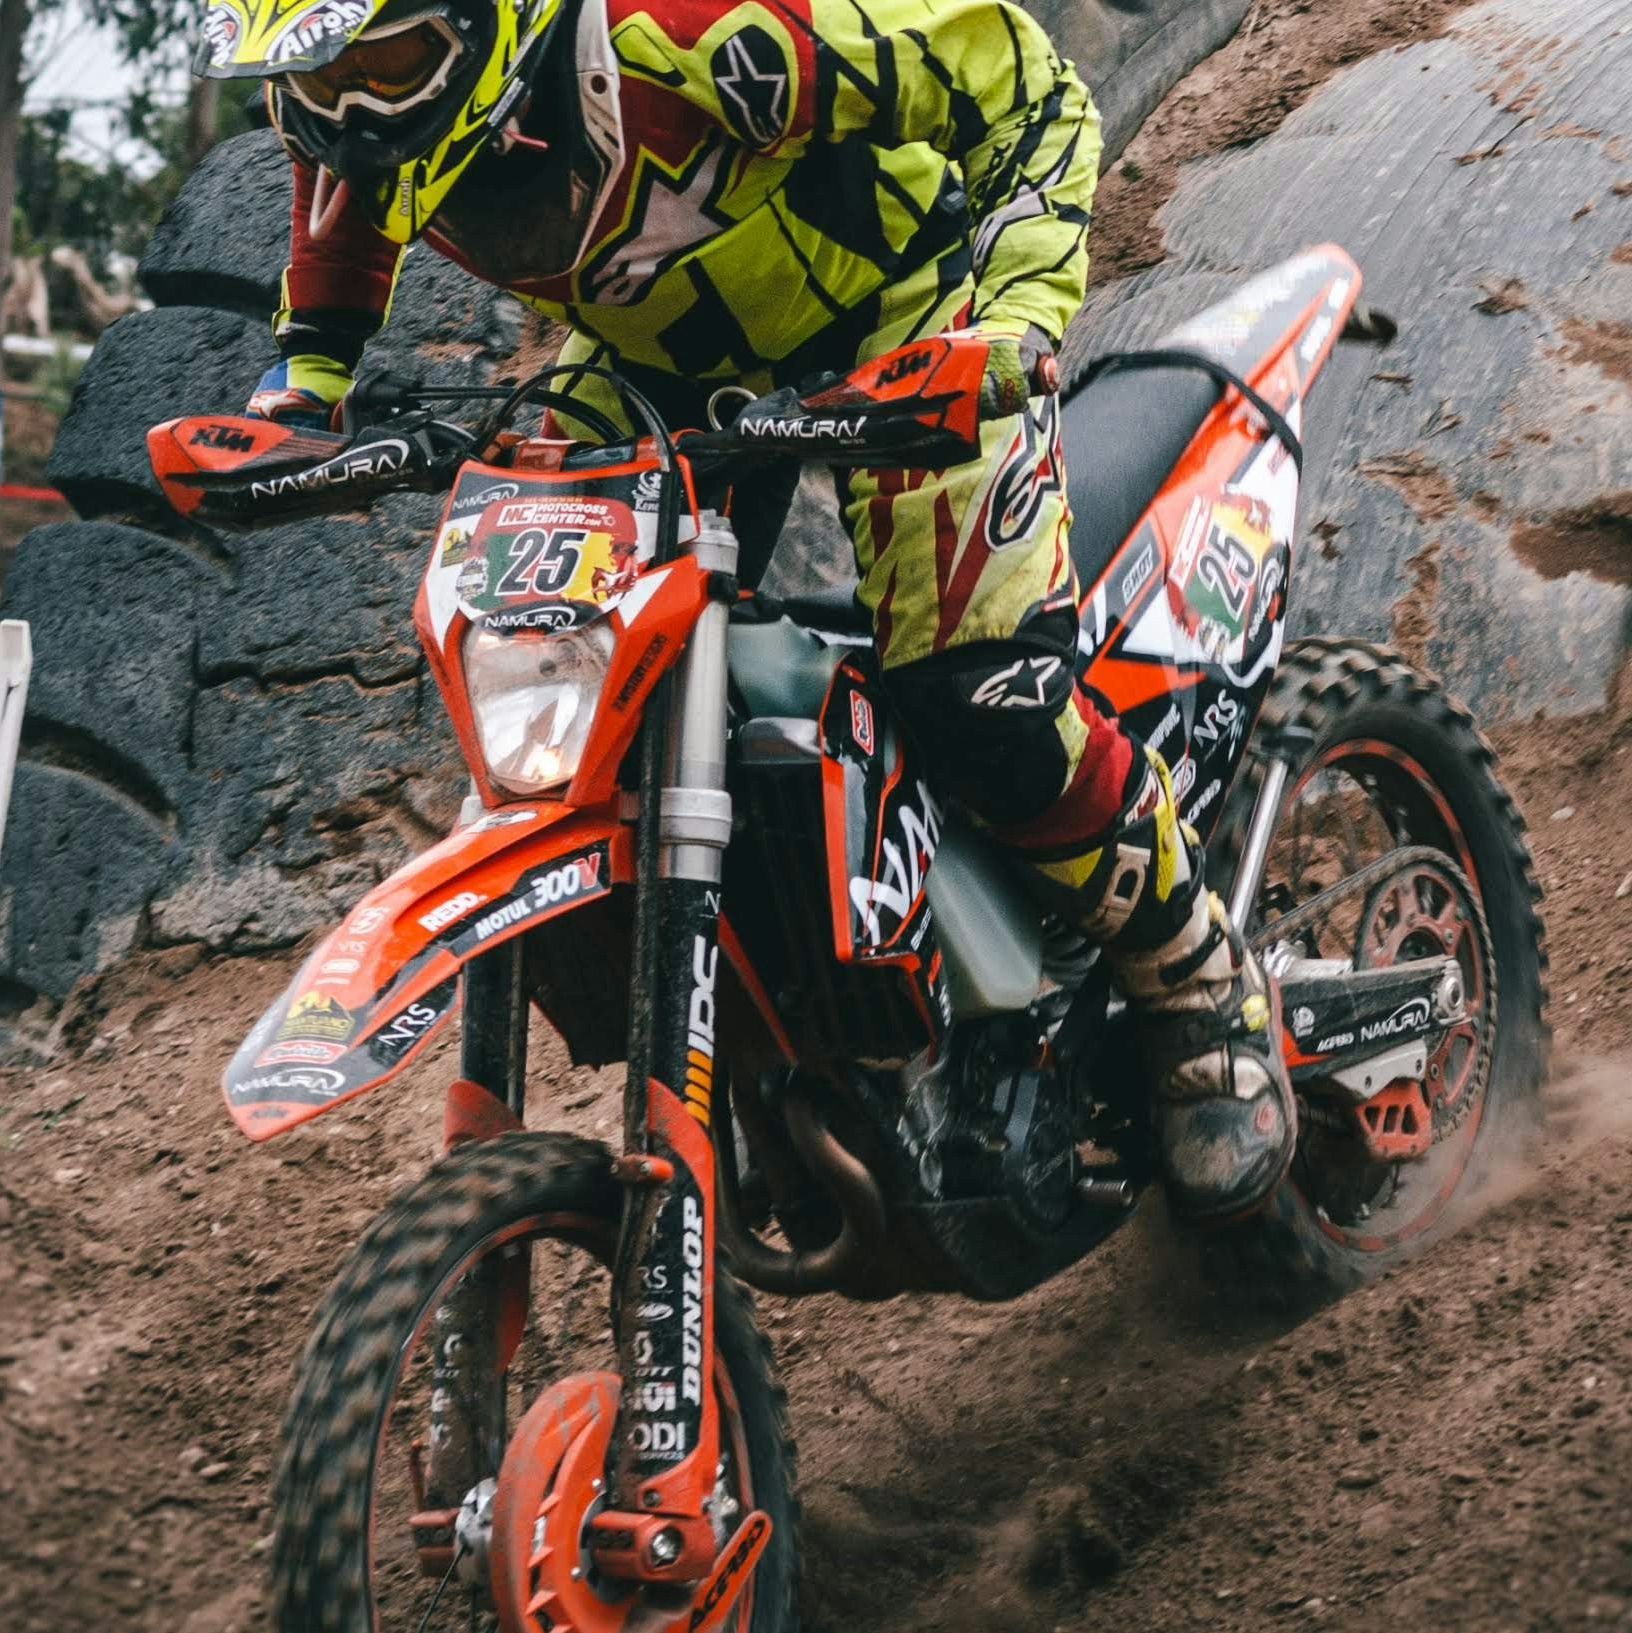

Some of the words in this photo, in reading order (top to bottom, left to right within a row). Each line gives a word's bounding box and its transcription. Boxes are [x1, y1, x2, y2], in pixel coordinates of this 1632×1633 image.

[278, 1, 367, 62] Airoh
[875, 351, 932, 389] KTM
[189, 424, 255, 453] KTM
[251, 447, 403, 499] NAMURA
[452, 488, 517, 511] NAMURA
[537, 502, 608, 515] MOTOCROSS
[494, 527, 590, 597] 25
[1196, 523, 1257, 623] 25
[485, 611, 570, 629] NAMURA
[475, 899, 532, 940] MOTUL
[530, 852, 602, 909] 300V
[1361, 1004, 1427, 1043] NAMURA
[682, 1195, 704, 1406] DUNLOP
